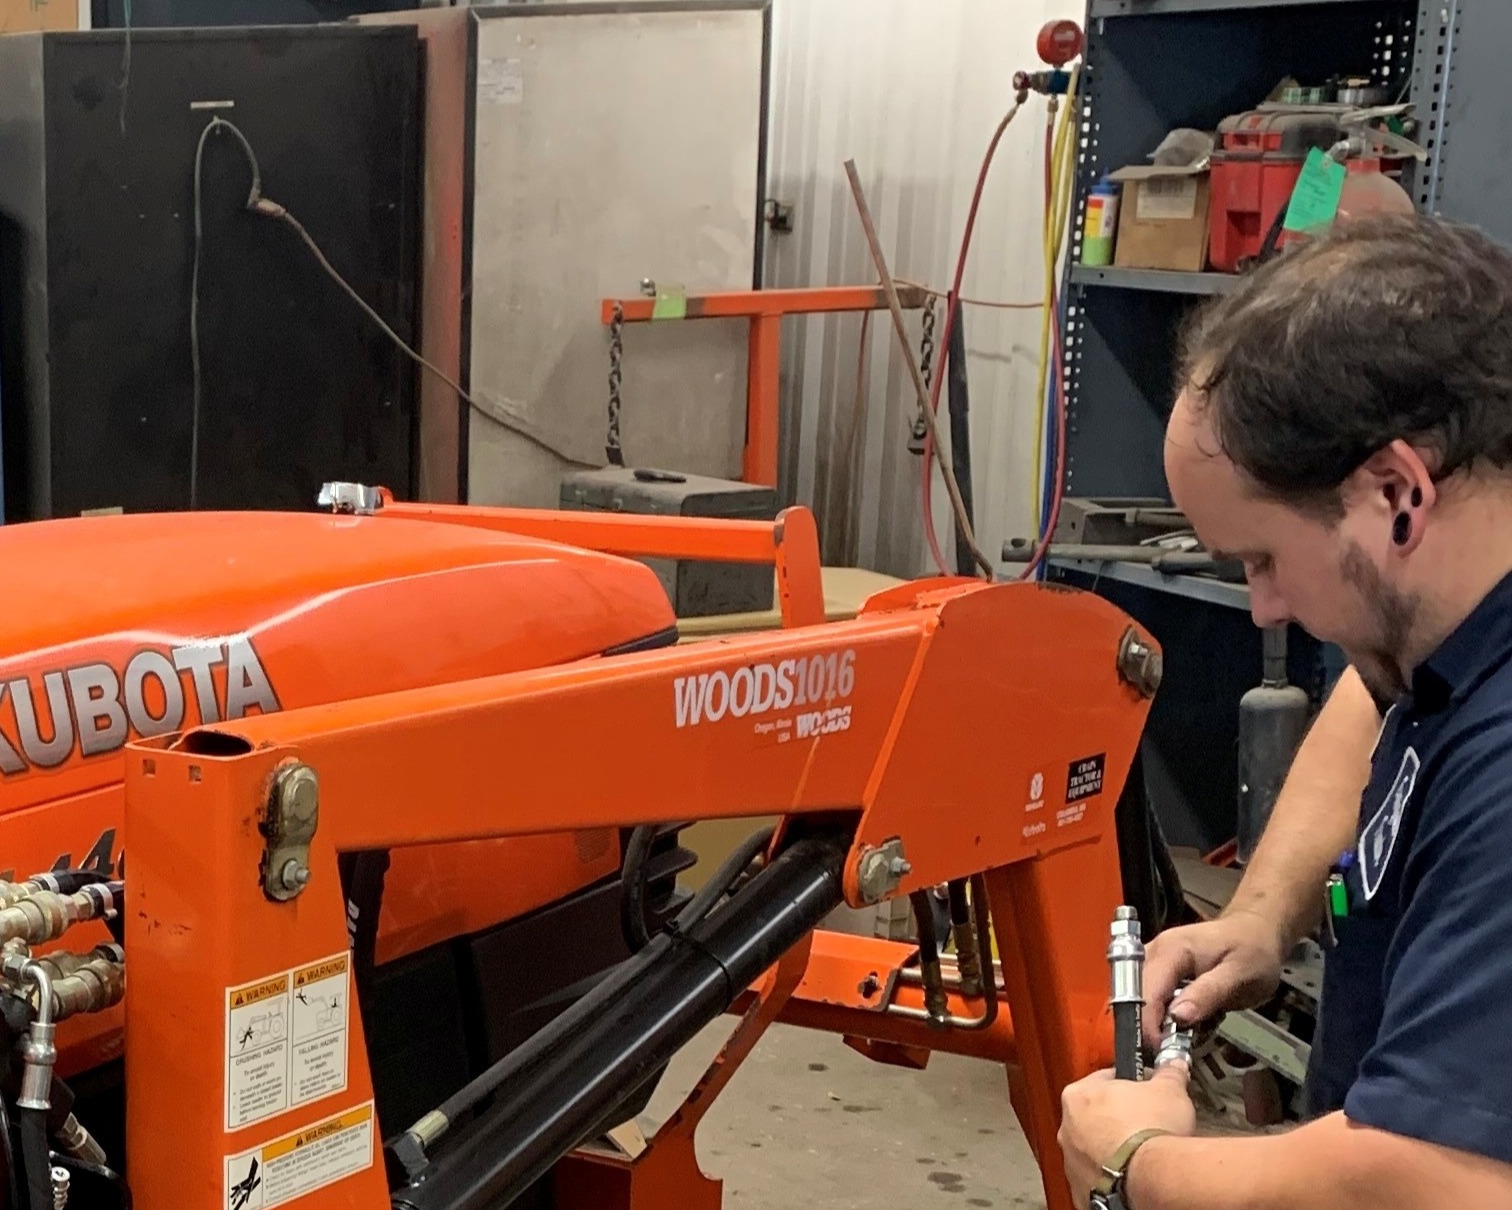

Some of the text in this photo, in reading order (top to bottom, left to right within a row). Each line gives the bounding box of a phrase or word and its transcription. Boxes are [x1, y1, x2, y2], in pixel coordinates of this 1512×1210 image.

[796, 706, 852, 739] WOODS
[306, 958, 346, 982] WARNING
[245, 979, 286, 1002] WARNING
[305, 1120, 344, 1142] WARNING
